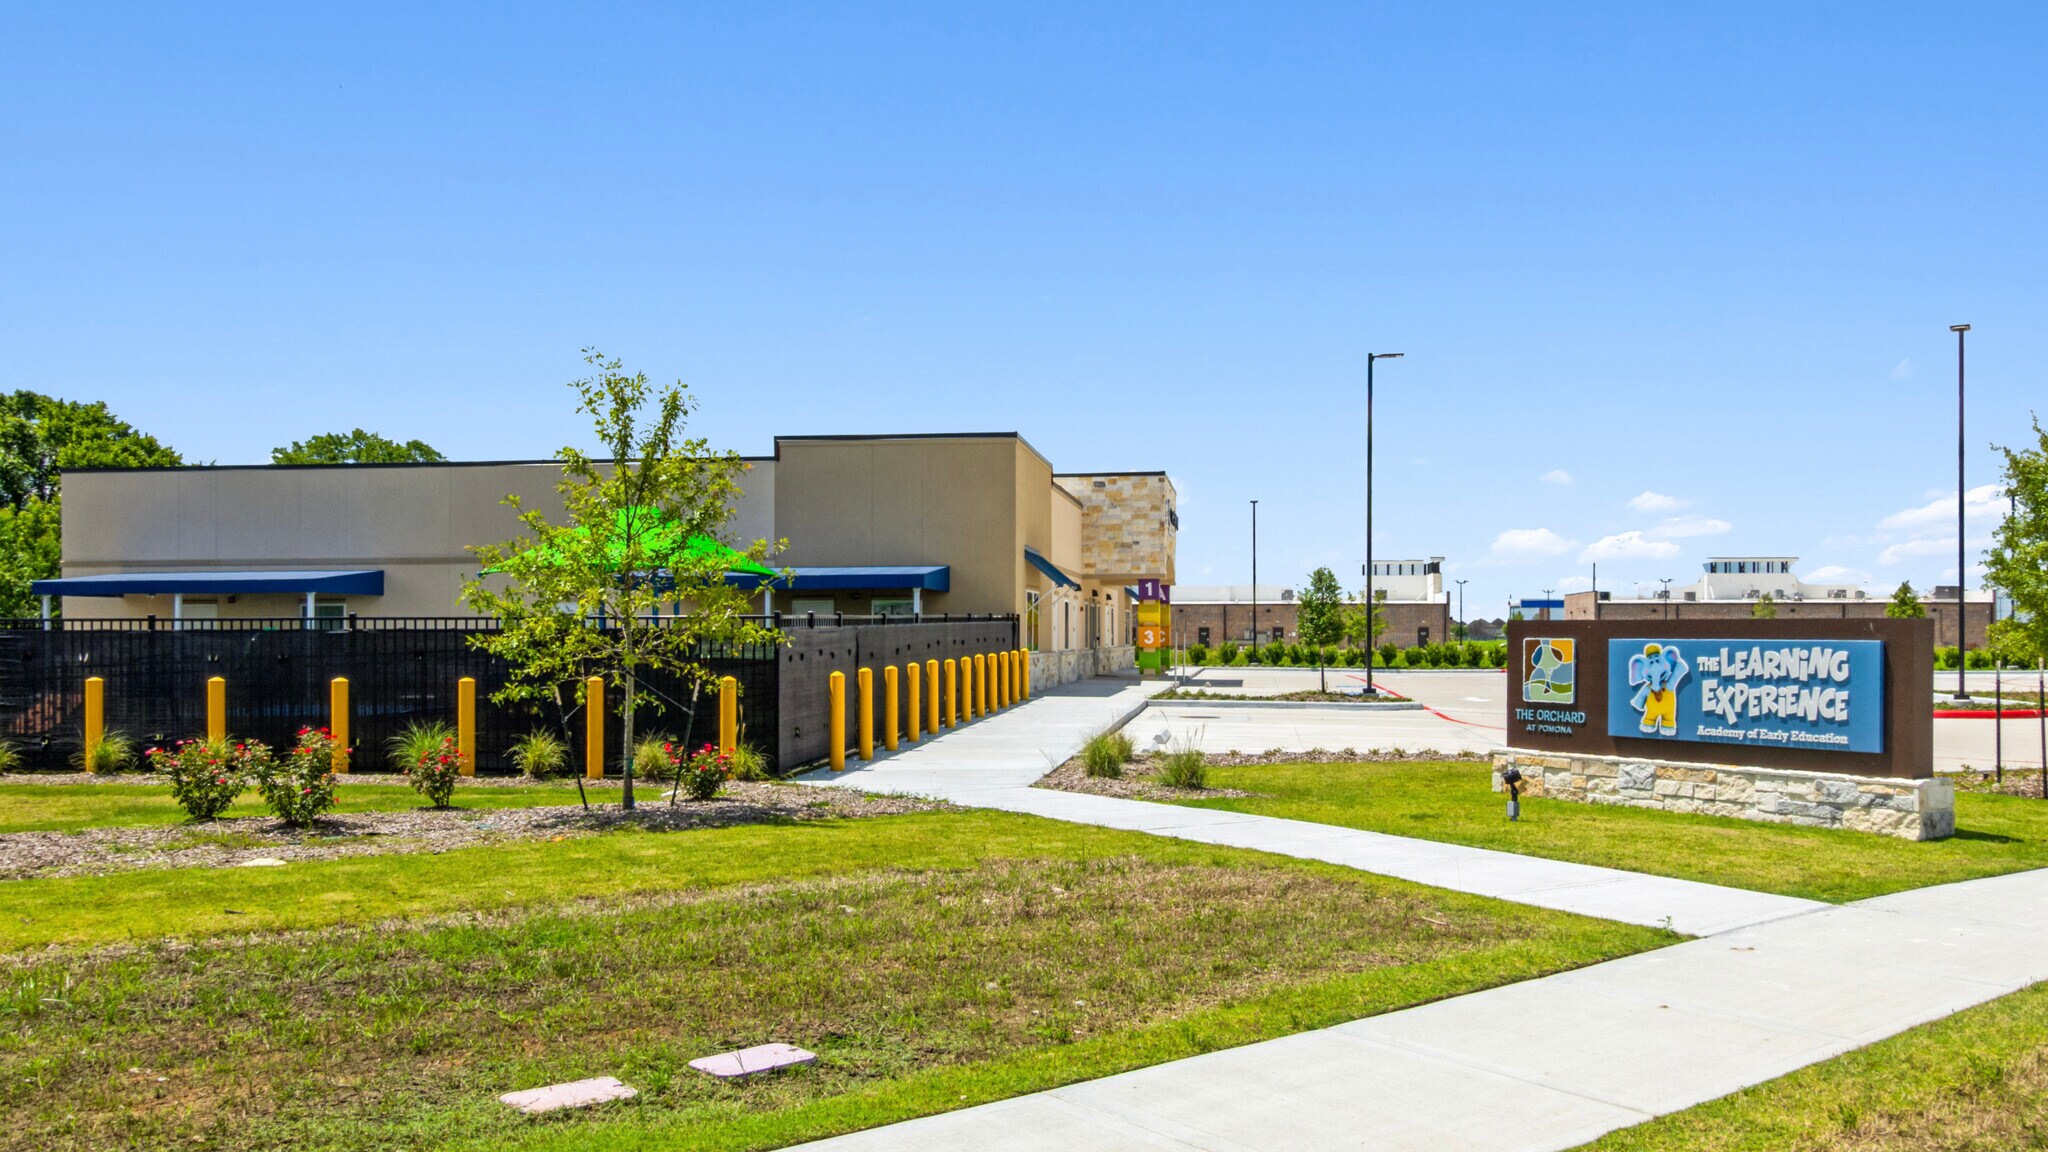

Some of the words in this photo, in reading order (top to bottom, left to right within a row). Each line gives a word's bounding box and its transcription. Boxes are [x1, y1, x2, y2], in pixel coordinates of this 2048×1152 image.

[1145, 582, 1152, 596] 1
[1159, 583, 1167, 600] A
[1144, 630, 1154, 644] 3
[1697, 656, 1720, 672] THE
[1515, 708, 1534, 720] THE
[1536, 709, 1586, 724] ORCHARD
[1538, 724, 1572, 734] POMONA
[1697, 725, 1746, 740] Academy
[1747, 728, 1759, 739] of
[1759, 729, 1789, 743] Early
[1791, 731, 1849, 744] Education
